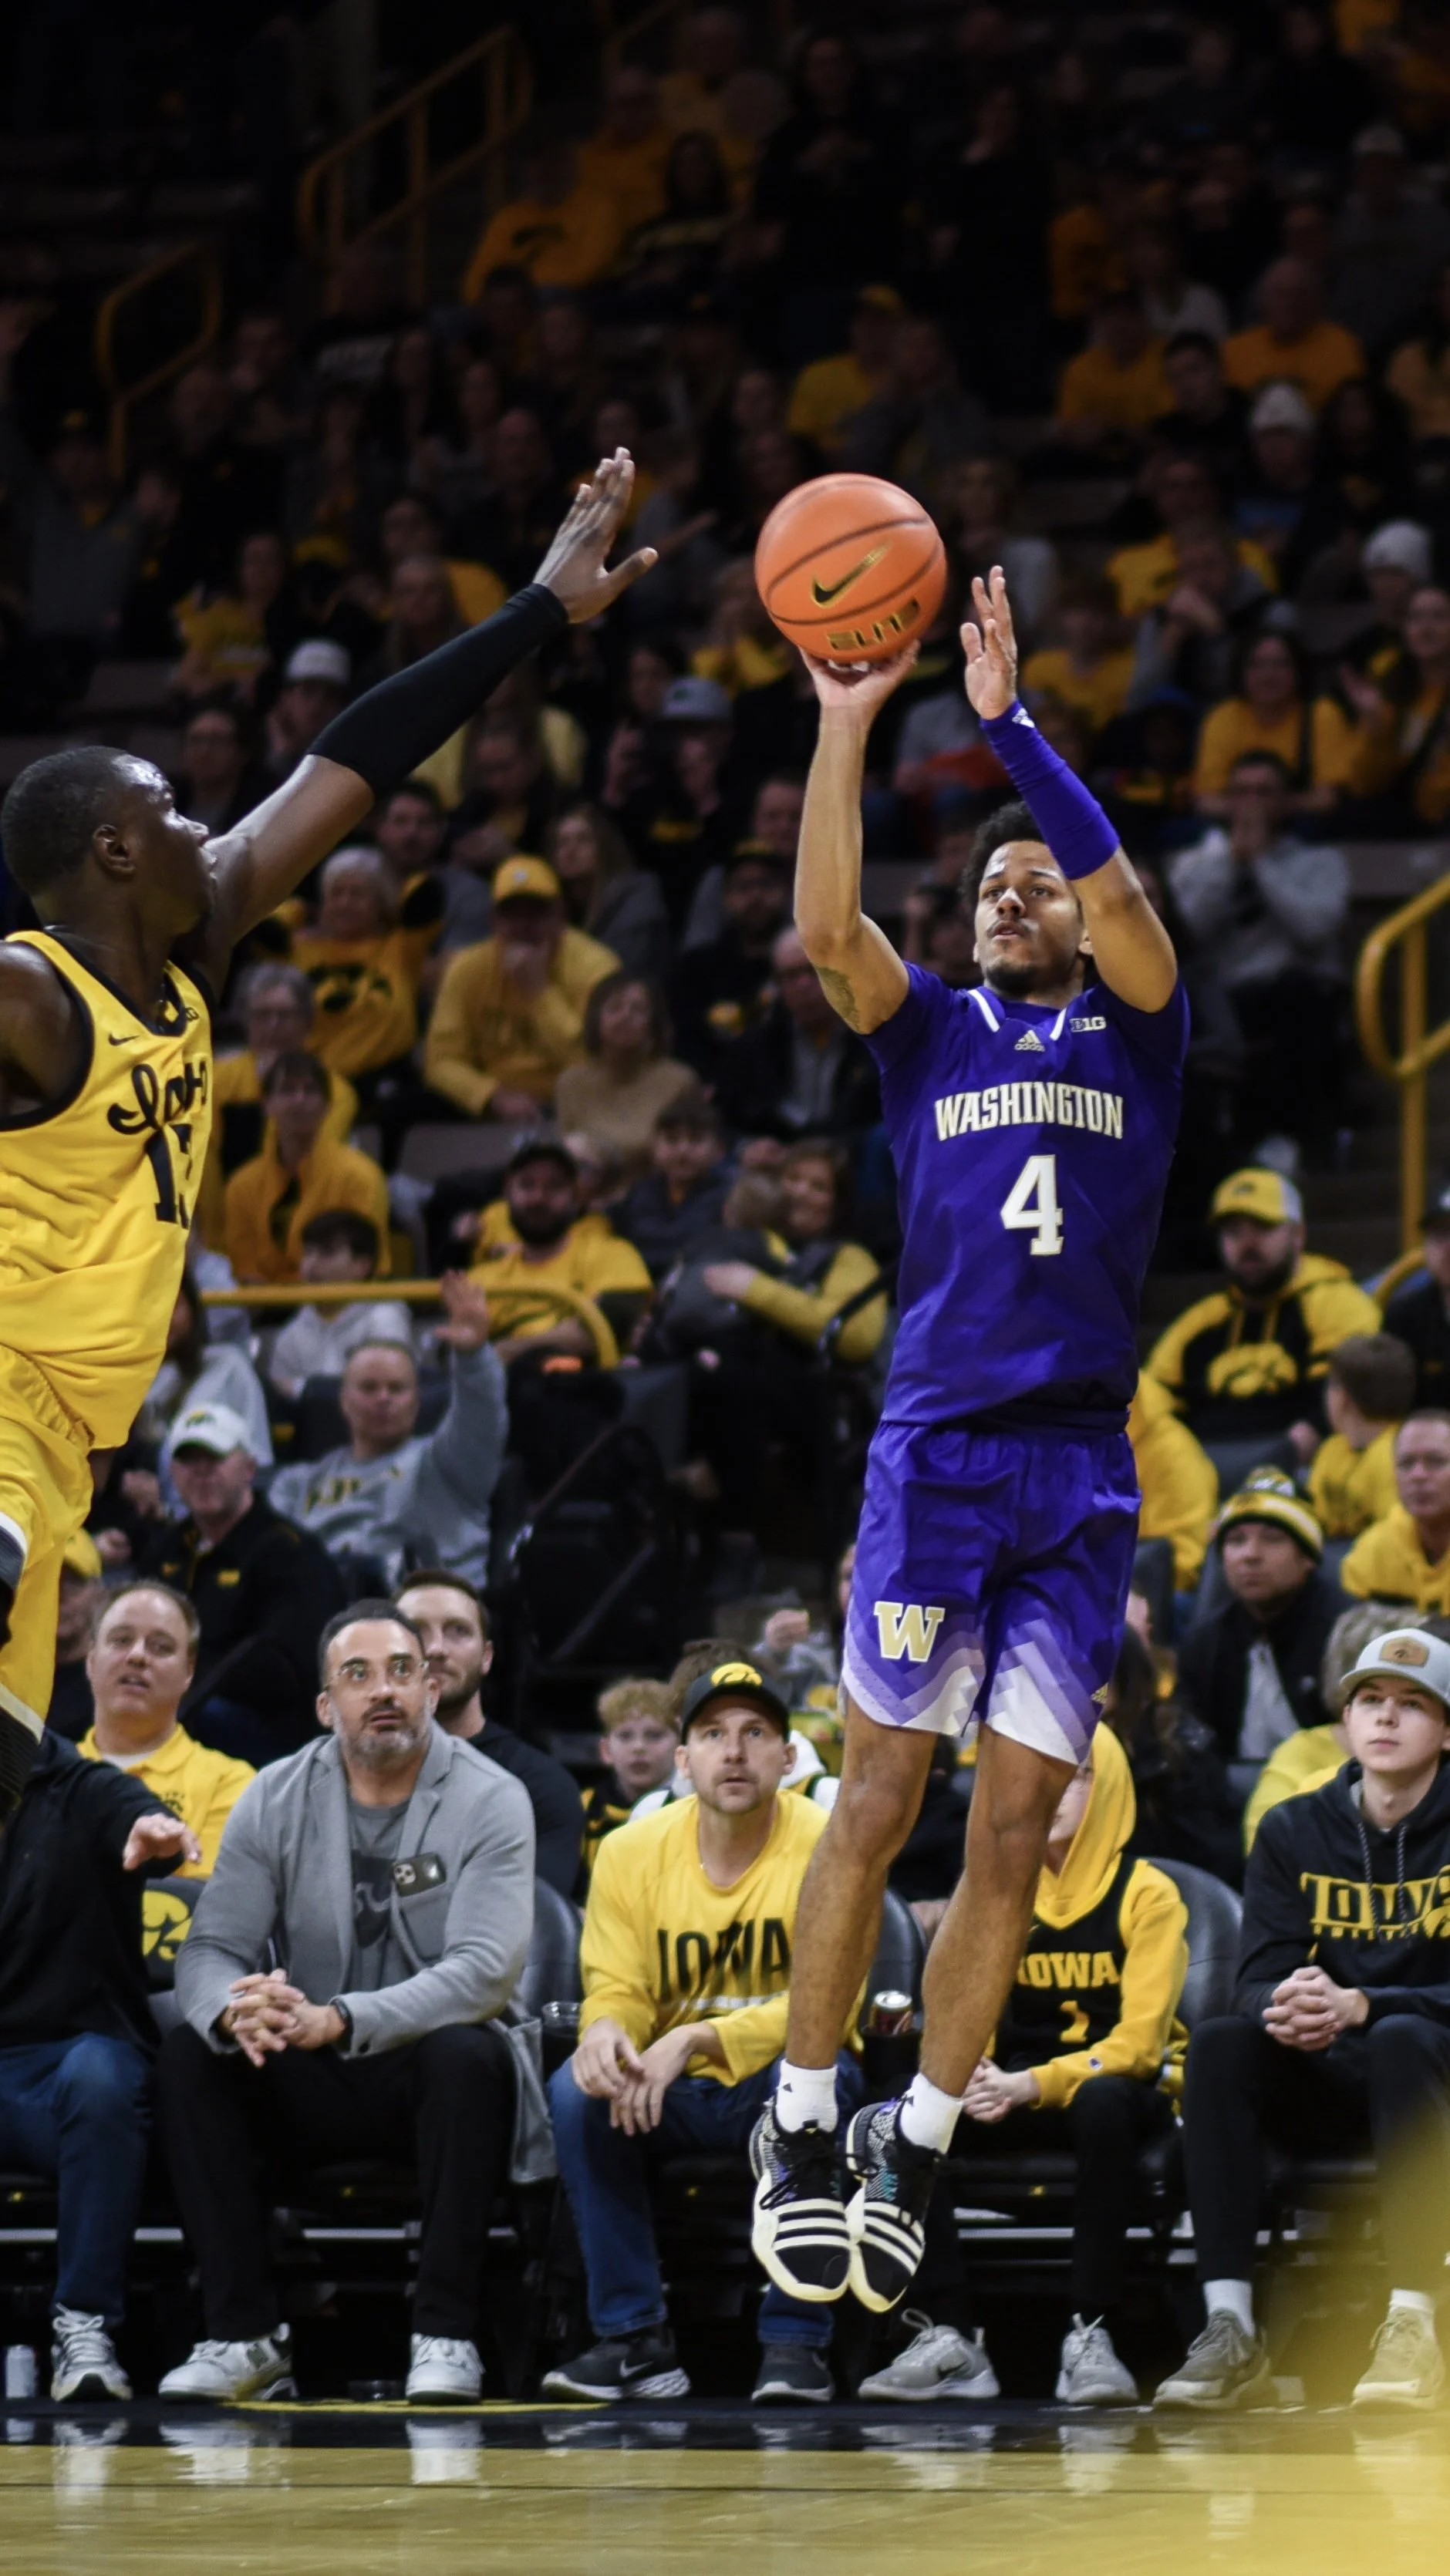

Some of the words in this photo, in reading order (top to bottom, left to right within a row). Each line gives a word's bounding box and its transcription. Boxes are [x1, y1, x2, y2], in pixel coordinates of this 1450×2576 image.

[934, 1081, 1124, 1141] WASHINGTON
[1000, 1154, 1064, 1256] 4
[873, 1601, 946, 1662] W
[1300, 1871, 1441, 1930] IOW
[657, 1918, 791, 2003] IOWA
[1017, 1951, 1120, 1988] IOWA
